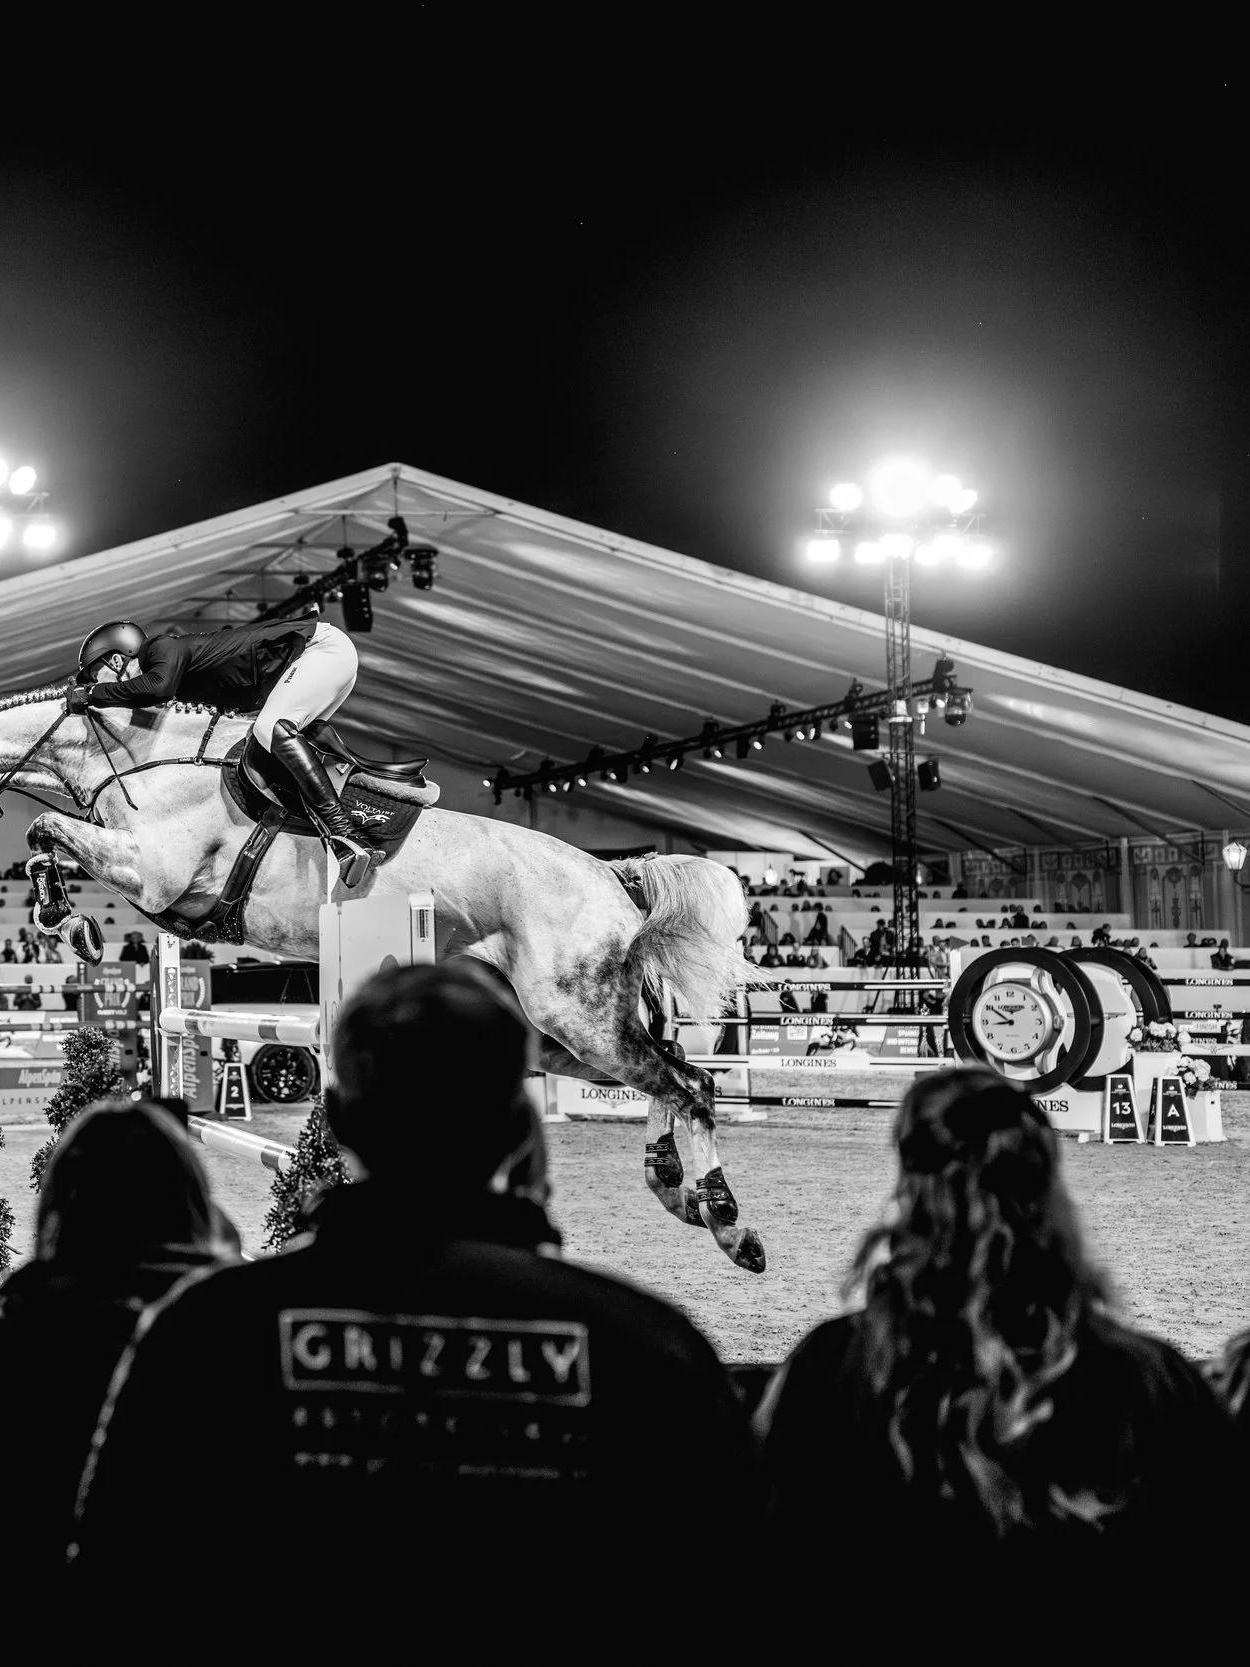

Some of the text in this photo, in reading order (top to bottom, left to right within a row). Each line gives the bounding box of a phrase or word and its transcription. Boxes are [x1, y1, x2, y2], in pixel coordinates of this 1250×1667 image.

[778, 983, 831, 992] LONGINES
[1184, 978, 1234, 986] LONGINES
[780, 1016, 834, 1026] LONGINES
[183, 1033, 201, 1099] AlpenSp
[780, 1058, 837, 1068] LONGINES
[230, 1085, 240, 1098] 2
[581, 1087, 648, 1101] LONGINES
[782, 1097, 836, 1107] LONGINES
[1112, 1101, 1132, 1115] 13
[1166, 1103, 1181, 1118] A
[292, 1321, 581, 1385] GRIZZLY
